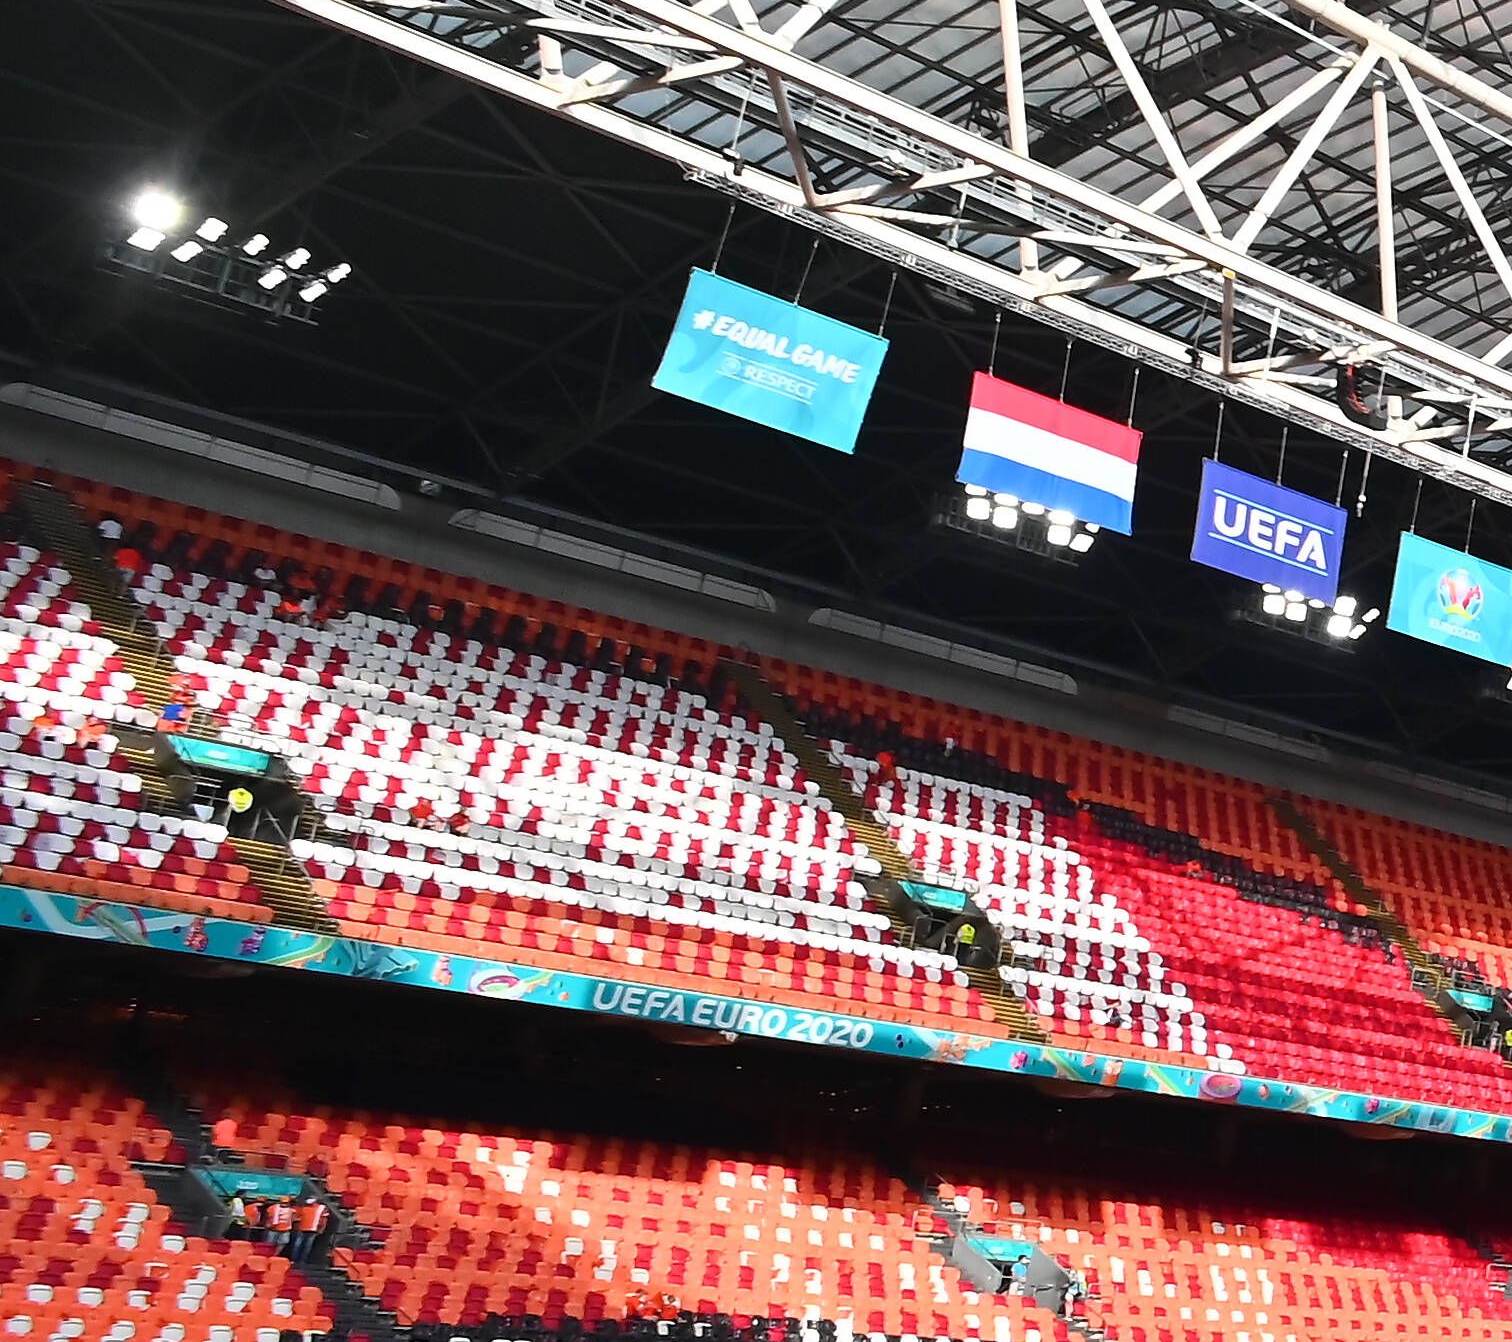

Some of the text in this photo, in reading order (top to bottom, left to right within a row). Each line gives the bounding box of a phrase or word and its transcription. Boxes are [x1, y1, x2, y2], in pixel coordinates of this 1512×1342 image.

[744, 365, 817, 401] RESPECT
[1213, 495, 1328, 570] UEFA
[592, 983, 874, 1048] UEFA EURO 2020
